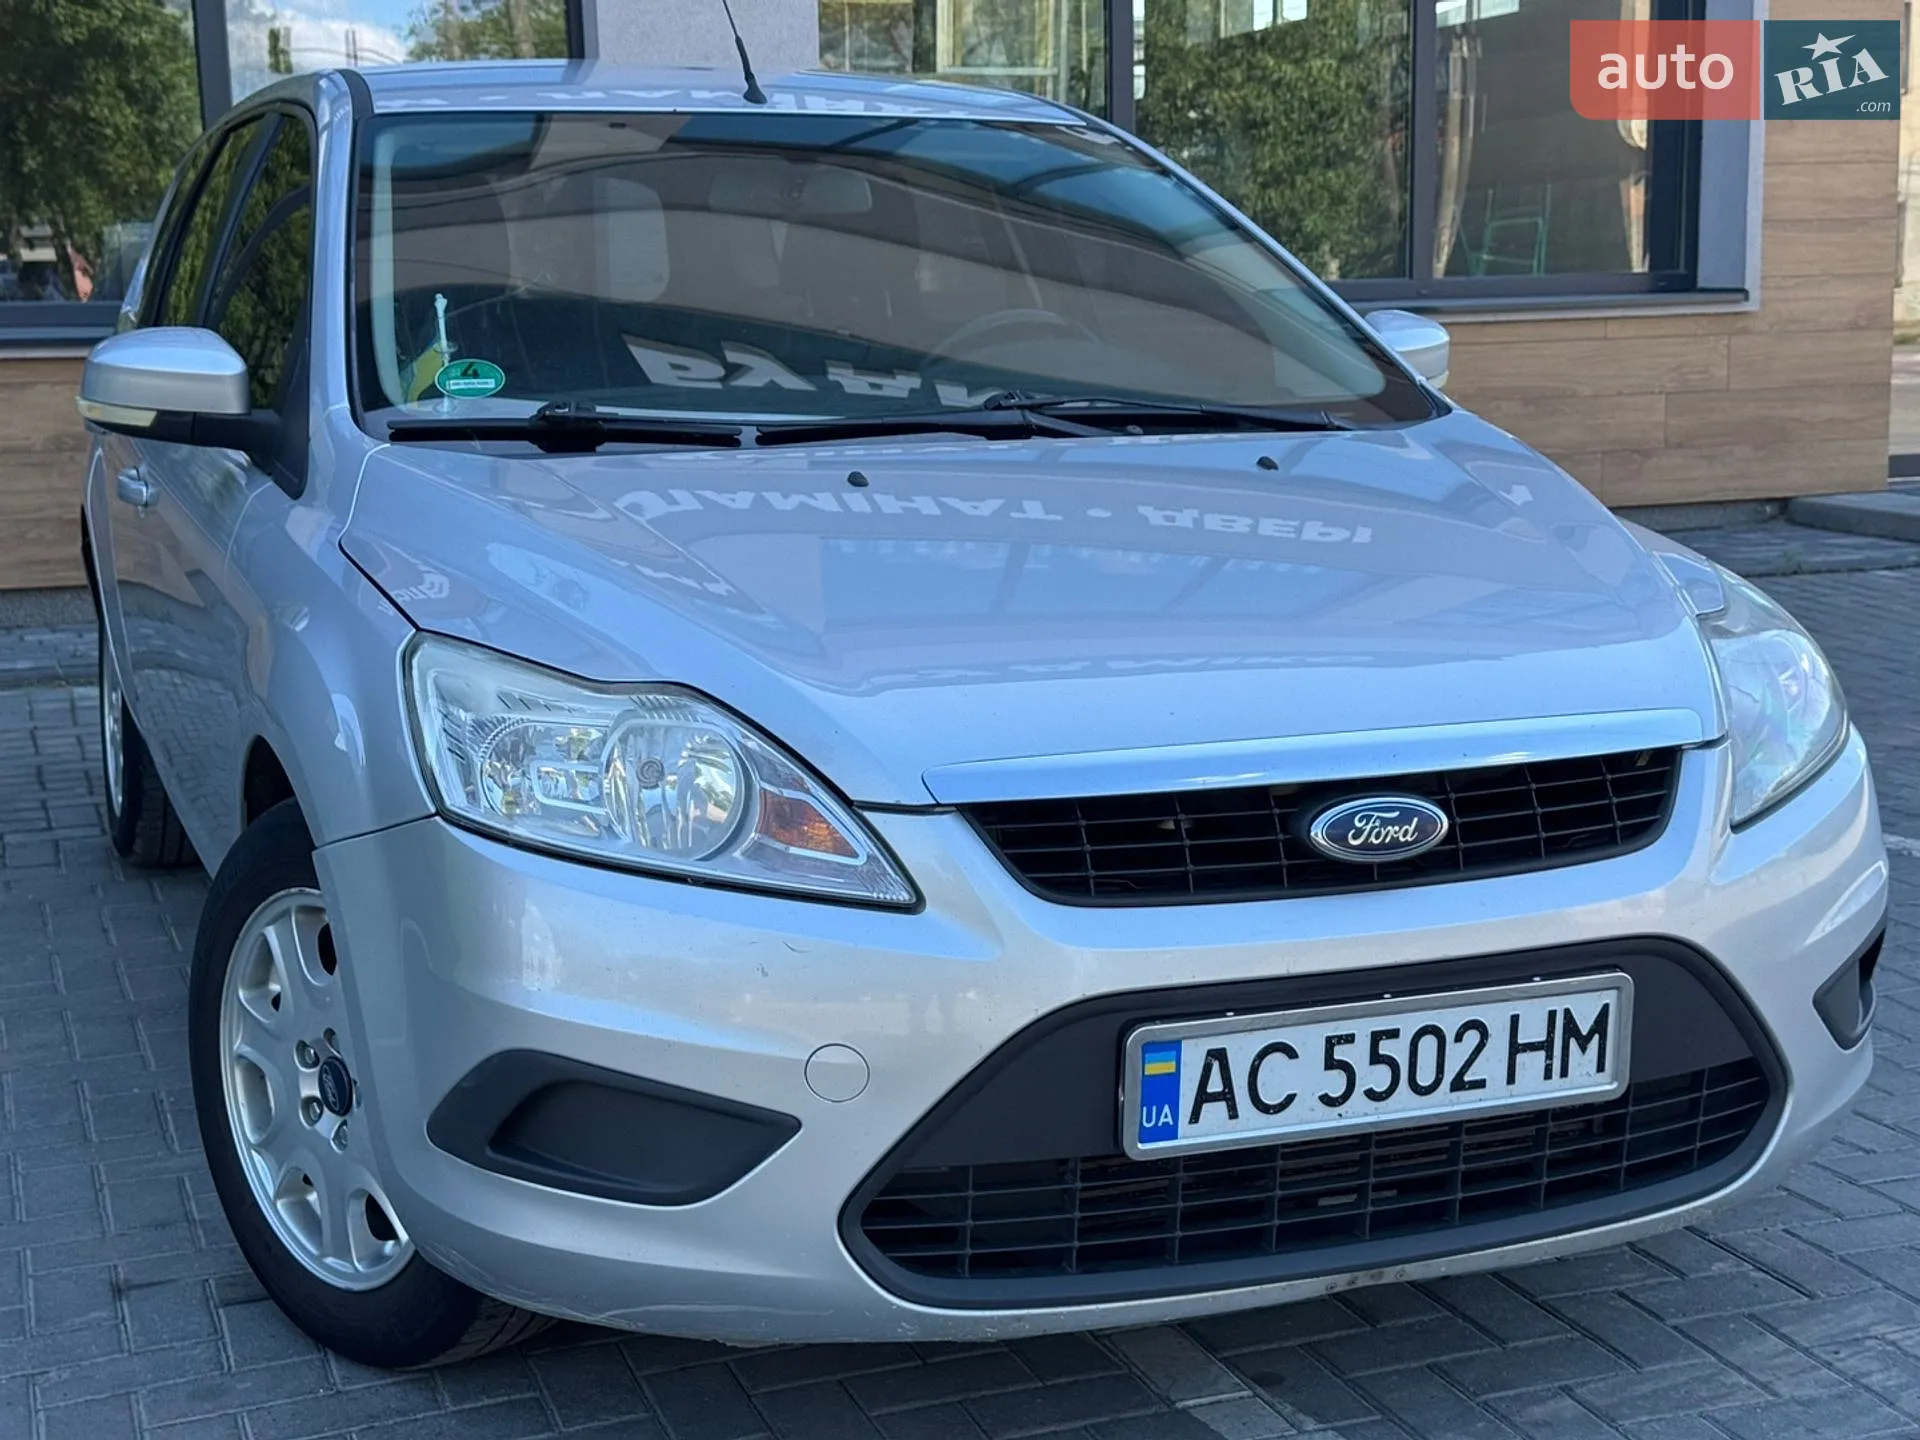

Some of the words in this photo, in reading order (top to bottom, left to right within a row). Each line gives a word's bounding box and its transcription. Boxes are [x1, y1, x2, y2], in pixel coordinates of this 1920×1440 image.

[1348, 811, 1418, 846] Ford
[1188, 1041, 1300, 1125] AC
[1317, 1018, 1490, 1108] 5502
[1506, 1002, 1611, 1086] HM
[1142, 1104, 1174, 1128] UA
